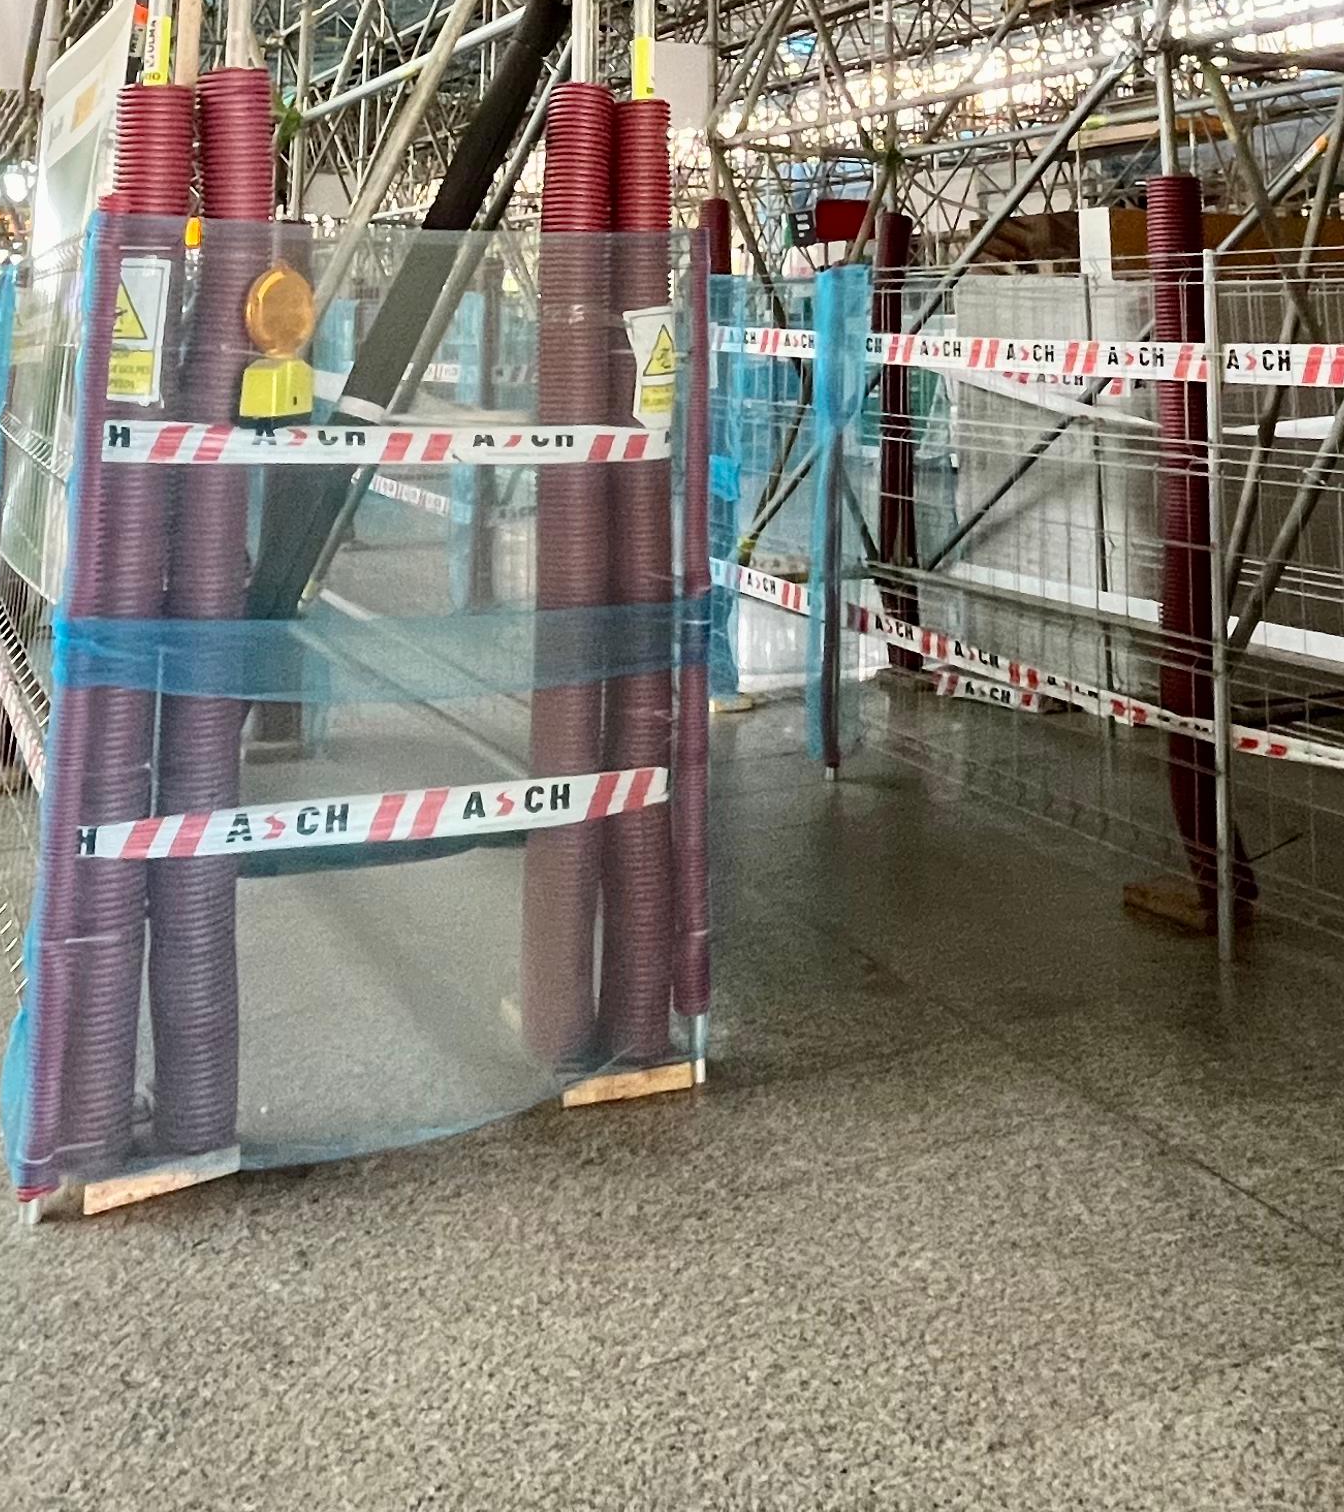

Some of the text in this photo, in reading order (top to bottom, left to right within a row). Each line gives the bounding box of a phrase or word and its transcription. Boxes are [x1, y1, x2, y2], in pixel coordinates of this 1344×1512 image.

[920, 340, 962, 358] ASCH
[1006, 342, 1055, 362] ASCH
[1107, 346, 1165, 367] ASCH
[1226, 349, 1292, 372] ASCH
[875, 614, 915, 641] ASCH
[225, 783, 571, 843] ASCH ASCH
